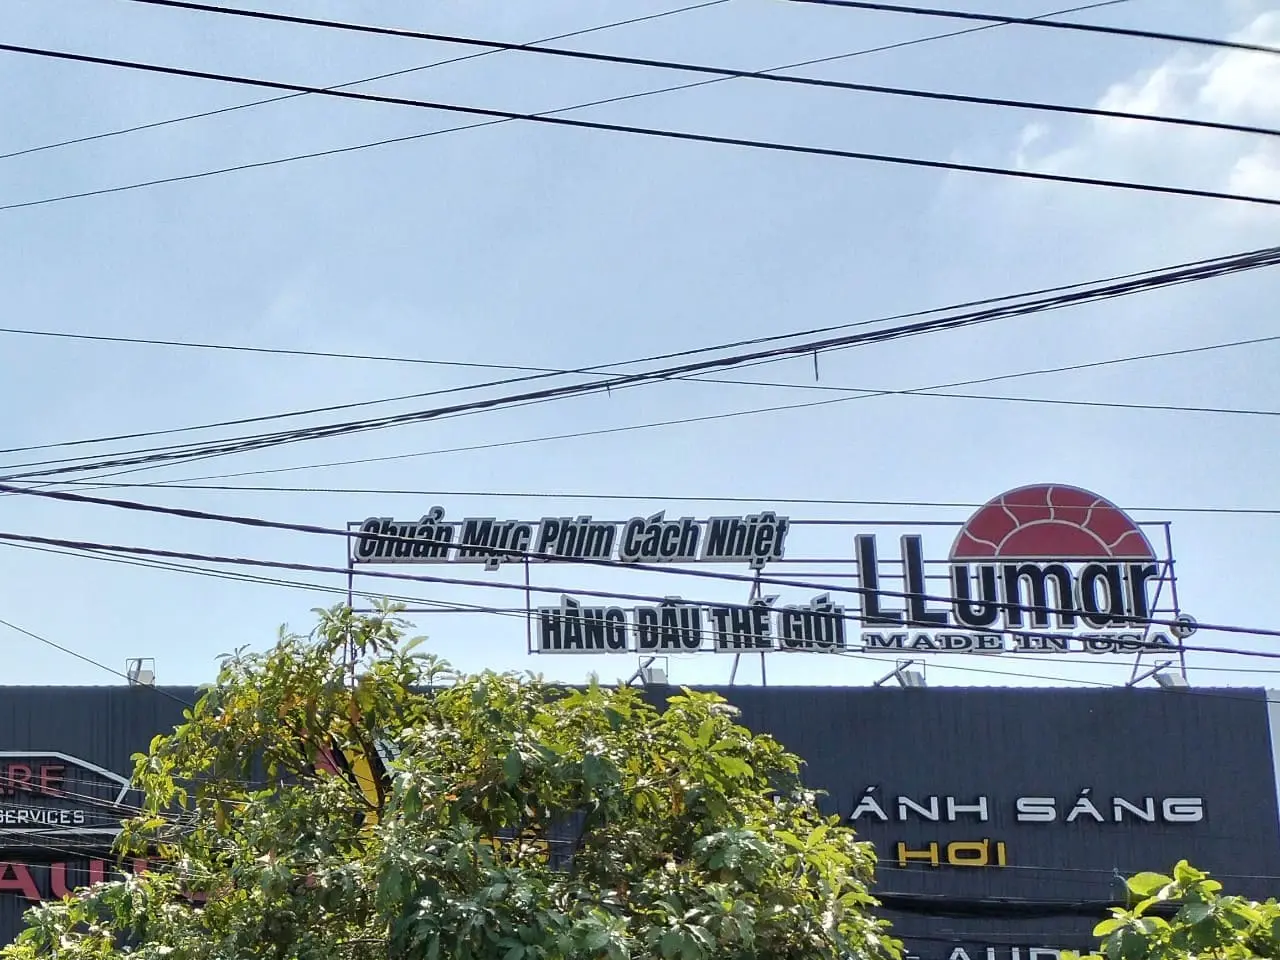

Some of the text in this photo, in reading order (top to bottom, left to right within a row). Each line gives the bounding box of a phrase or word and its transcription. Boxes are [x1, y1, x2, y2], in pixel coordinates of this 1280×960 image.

[534, 516, 617, 561] Phim
[619, 510, 701, 561] Cách
[701, 511, 789, 569] Nhiệt
[537, 595, 628, 653] HÀNG
[863, 632, 1186, 654] MADE IN USA
[850, 786, 1204, 822] ÁNH SÁNG
[898, 838, 1007, 867] HƠI
